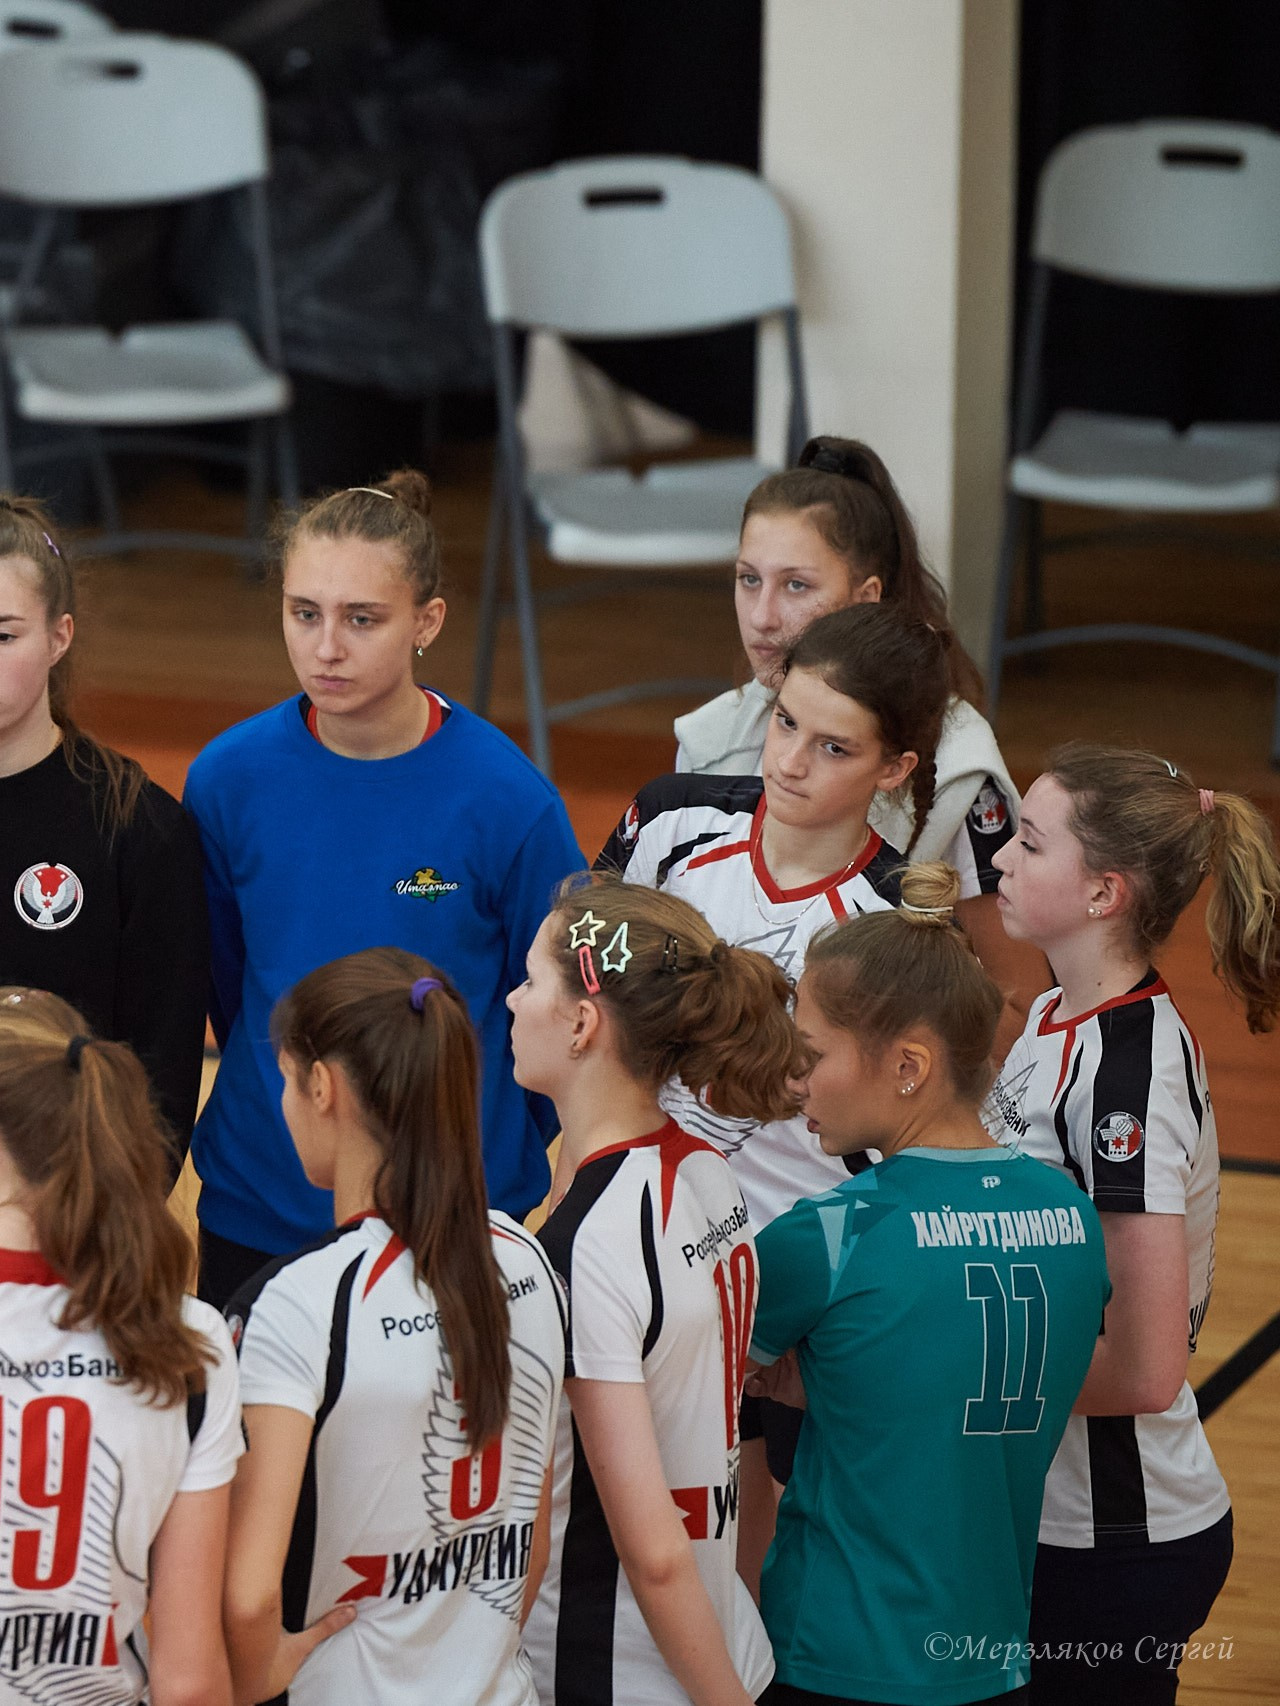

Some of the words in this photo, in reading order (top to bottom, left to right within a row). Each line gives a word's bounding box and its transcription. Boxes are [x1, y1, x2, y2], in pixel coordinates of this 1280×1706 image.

[910, 1204, 1087, 1253] ХАЙРУТДИНОВА
[962, 1263, 1048, 1436] 11
[388, 1521, 535, 1605] УДМУРТИЯ
